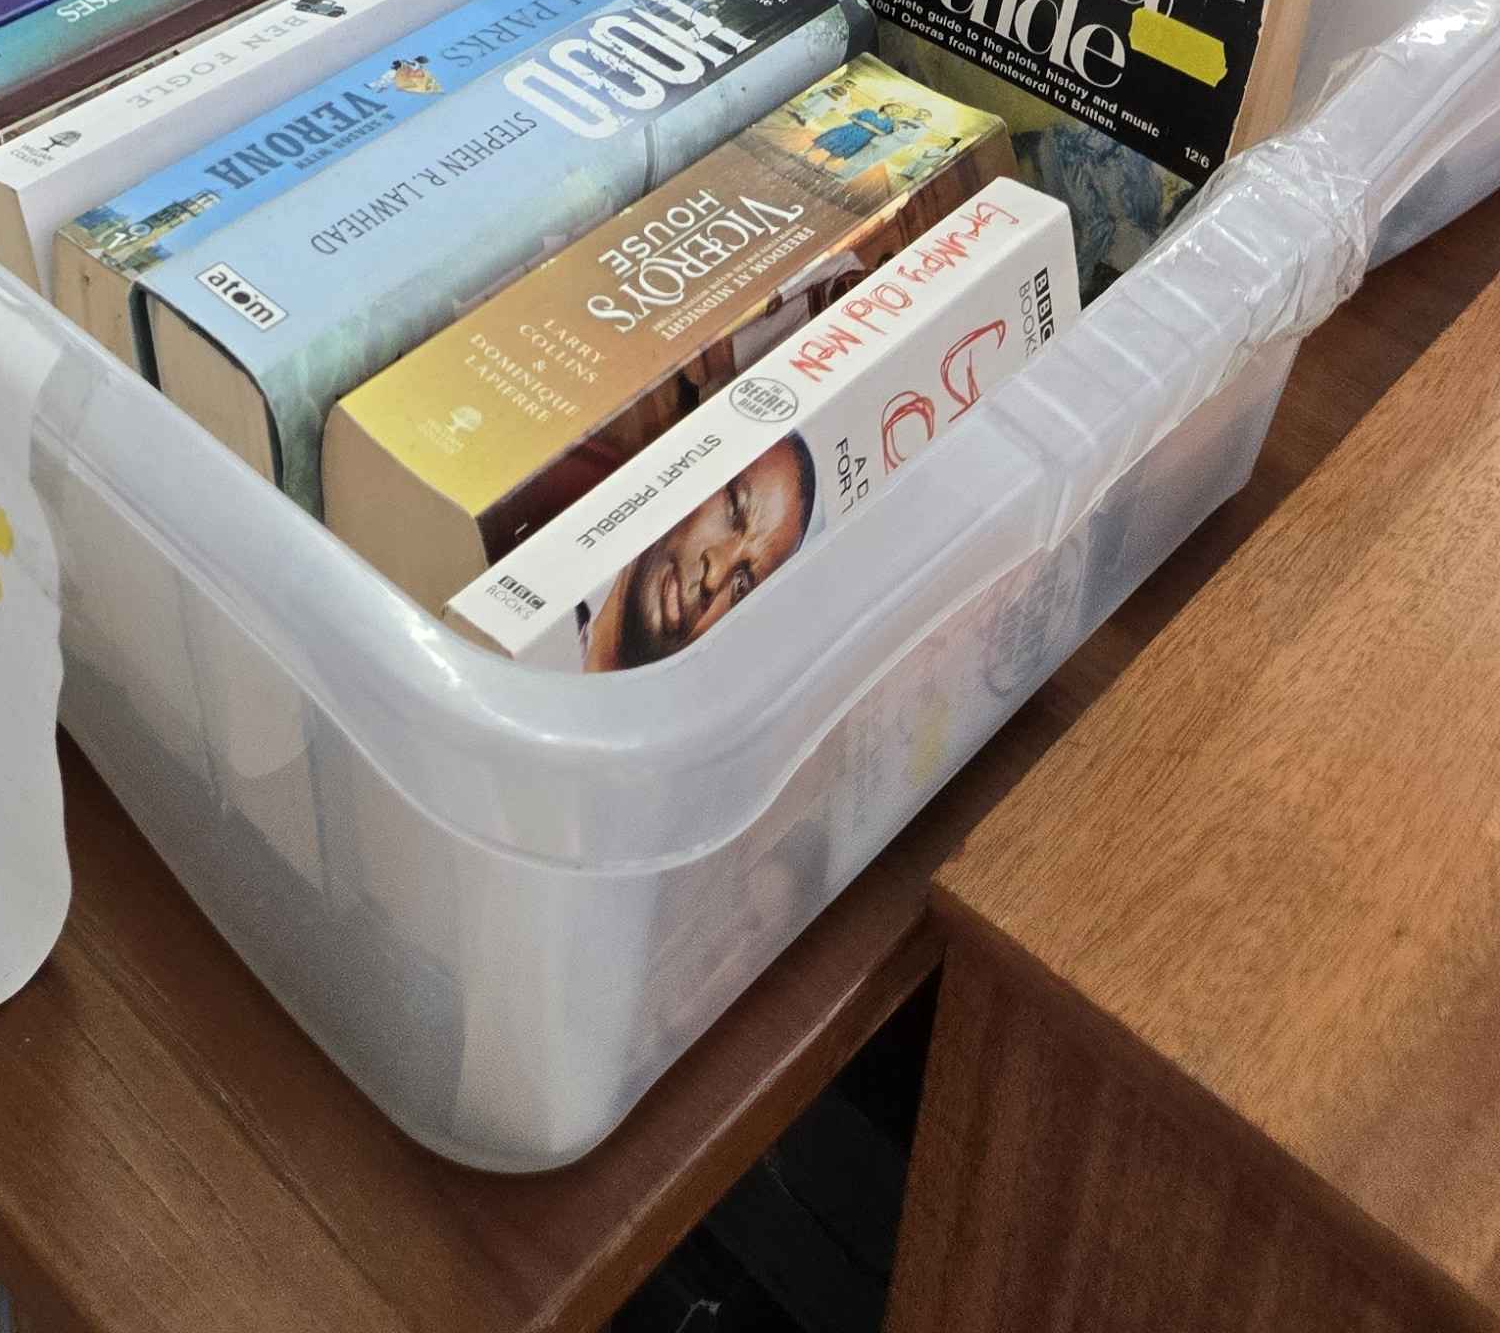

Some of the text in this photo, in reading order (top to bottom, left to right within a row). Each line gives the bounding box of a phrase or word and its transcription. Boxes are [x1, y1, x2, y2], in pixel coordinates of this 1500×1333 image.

[244, 14, 309, 54] BEN
[125, 48, 236, 110] FOGLE
[901, 9, 945, 42] Operas
[947, 35, 977, 58] from
[981, 49, 1050, 95] Monteverdi
[1071, 94, 1117, 132] Britten.
[927, 9, 962, 34] guide
[982, 32, 1003, 53] the
[1006, 44, 1043, 76] plots,
[1045, 61, 1090, 99] history
[1092, 84, 1118, 112] and
[1120, 99, 1161, 139] music
[203, 84, 395, 193] VERONA
[311, 110, 539, 257] STEPHEN LAWHEAD
[586, 189, 802, 334] VICEROY'S HOUSE
[205, 271, 279, 327] atom
[469, 332, 580, 417] DOMINIQUE
[520, 322, 599, 384] COLLINS
[542, 319, 605, 366] LARRY
[464, 354, 550, 422] LAPIERRE
[576, 434, 723, 550] STUART PREBBLE
[485, 583, 538, 623] BOOKS
[496, 574, 546, 610] BBC
